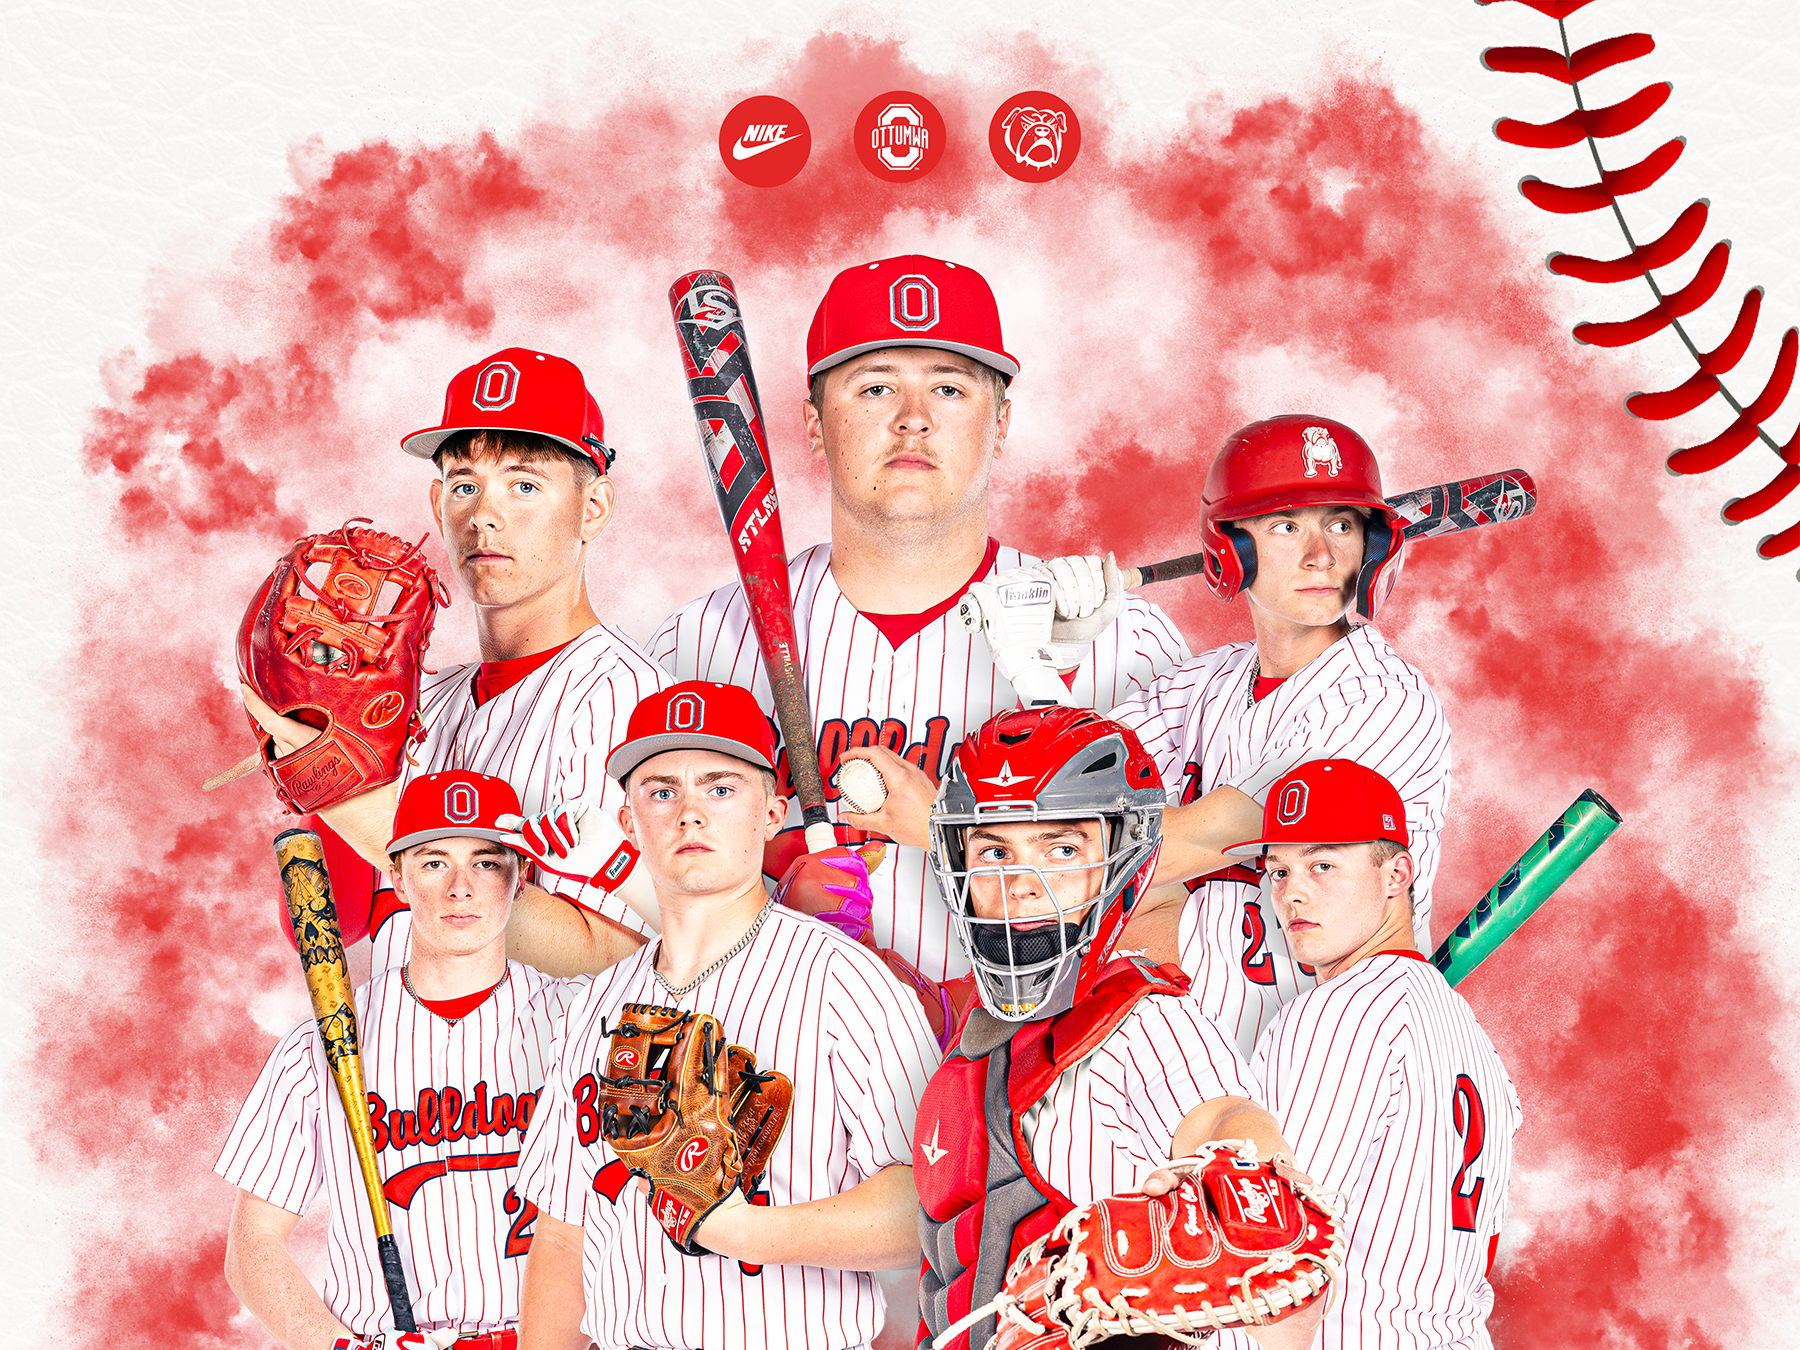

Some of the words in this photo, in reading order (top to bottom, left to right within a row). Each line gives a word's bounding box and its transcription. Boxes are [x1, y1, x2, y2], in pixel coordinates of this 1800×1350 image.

[743, 124, 789, 142] NIKE
[871, 124, 929, 150] OTTUMWA
[889, 274, 940, 332] O
[472, 361, 521, 411] O
[291, 756, 342, 796] Rawlings
[444, 782, 479, 824] O
[1277, 780, 1310, 826] O
